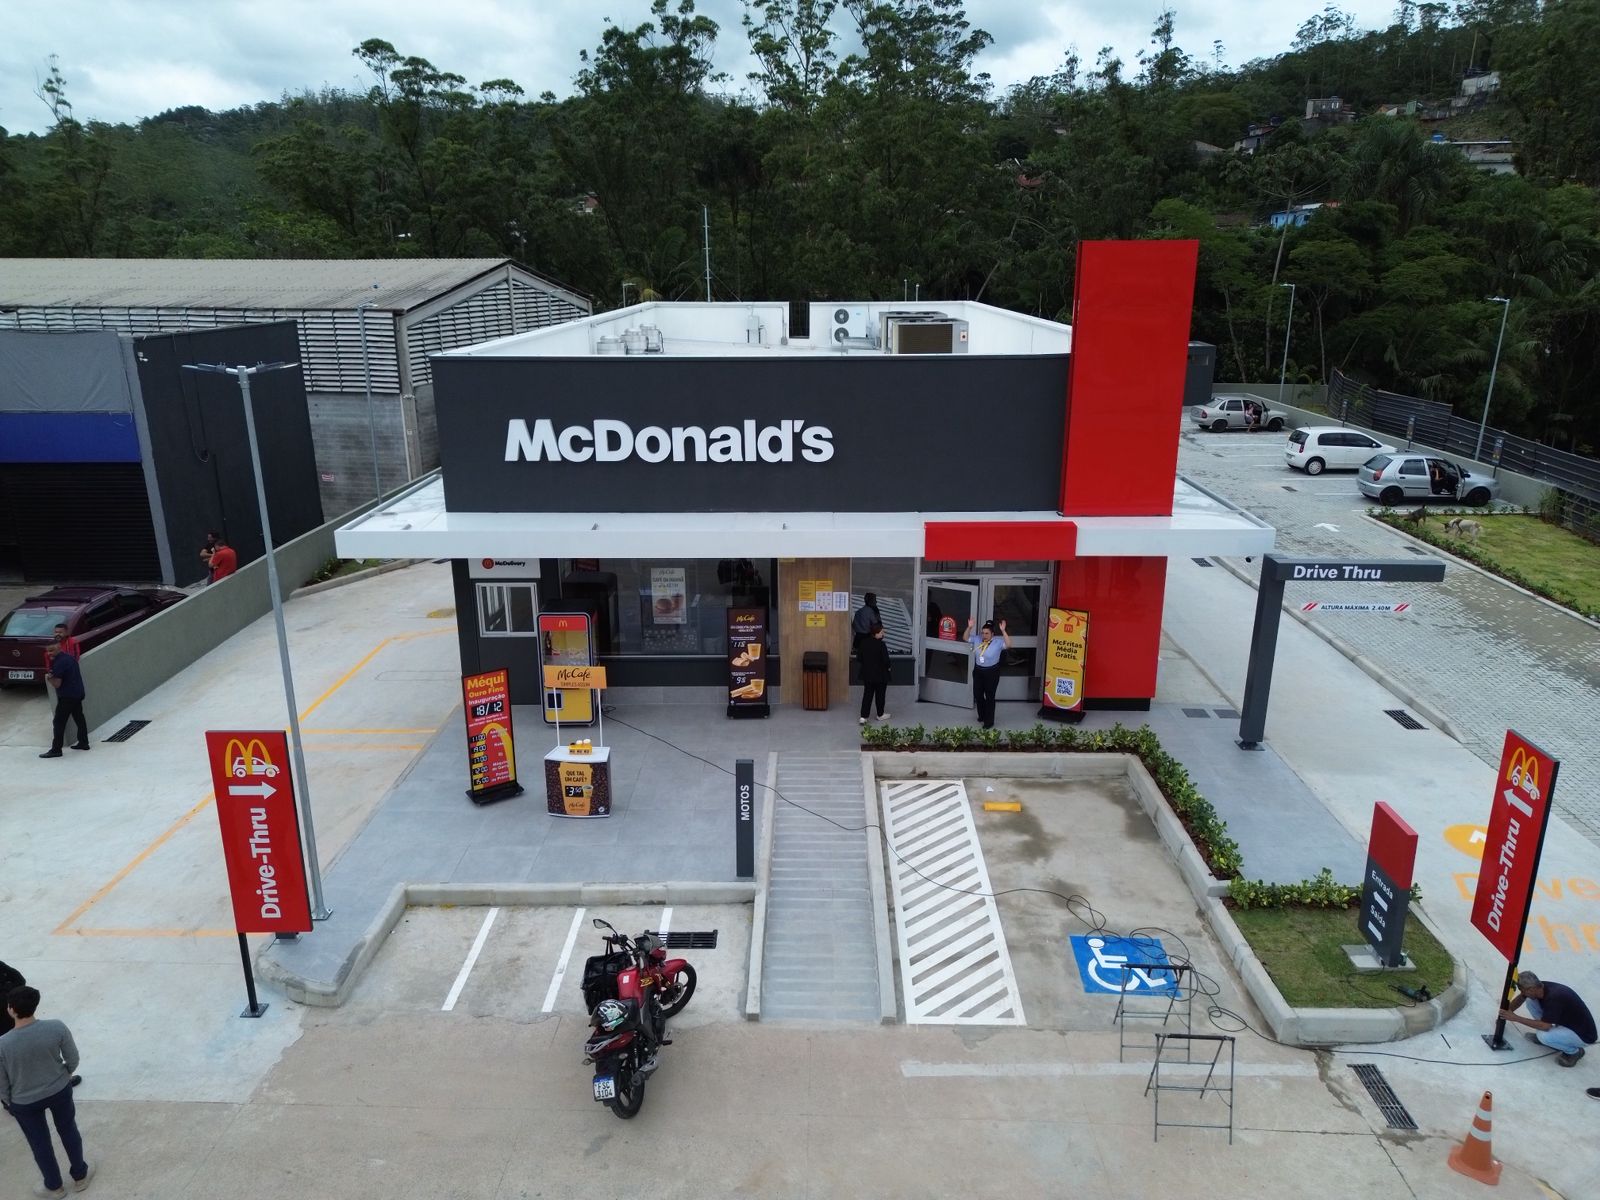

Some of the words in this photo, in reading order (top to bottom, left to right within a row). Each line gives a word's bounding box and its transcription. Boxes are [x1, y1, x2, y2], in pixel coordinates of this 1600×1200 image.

[504, 418, 835, 463] McDonald's
[1293, 564, 1338, 579] Drive
[1342, 565, 1382, 579] Thru
[1052, 639, 1083, 649] McFritas
[1056, 645, 1078, 654] Média
[467, 672, 504, 689] Méqui
[557, 668, 591, 681] McCafé
[468, 690, 487, 698] Ouro
[487, 686, 504, 695] Fino
[468, 693, 506, 706] Inauguração
[740, 784, 750, 821] MOTOS
[249, 807, 282, 919] Drive-Thru
[1487, 818, 1521, 932] Drive-Thru
[1371, 869, 1393, 900] Entrada
[596, 1089, 613, 1098] 3104
